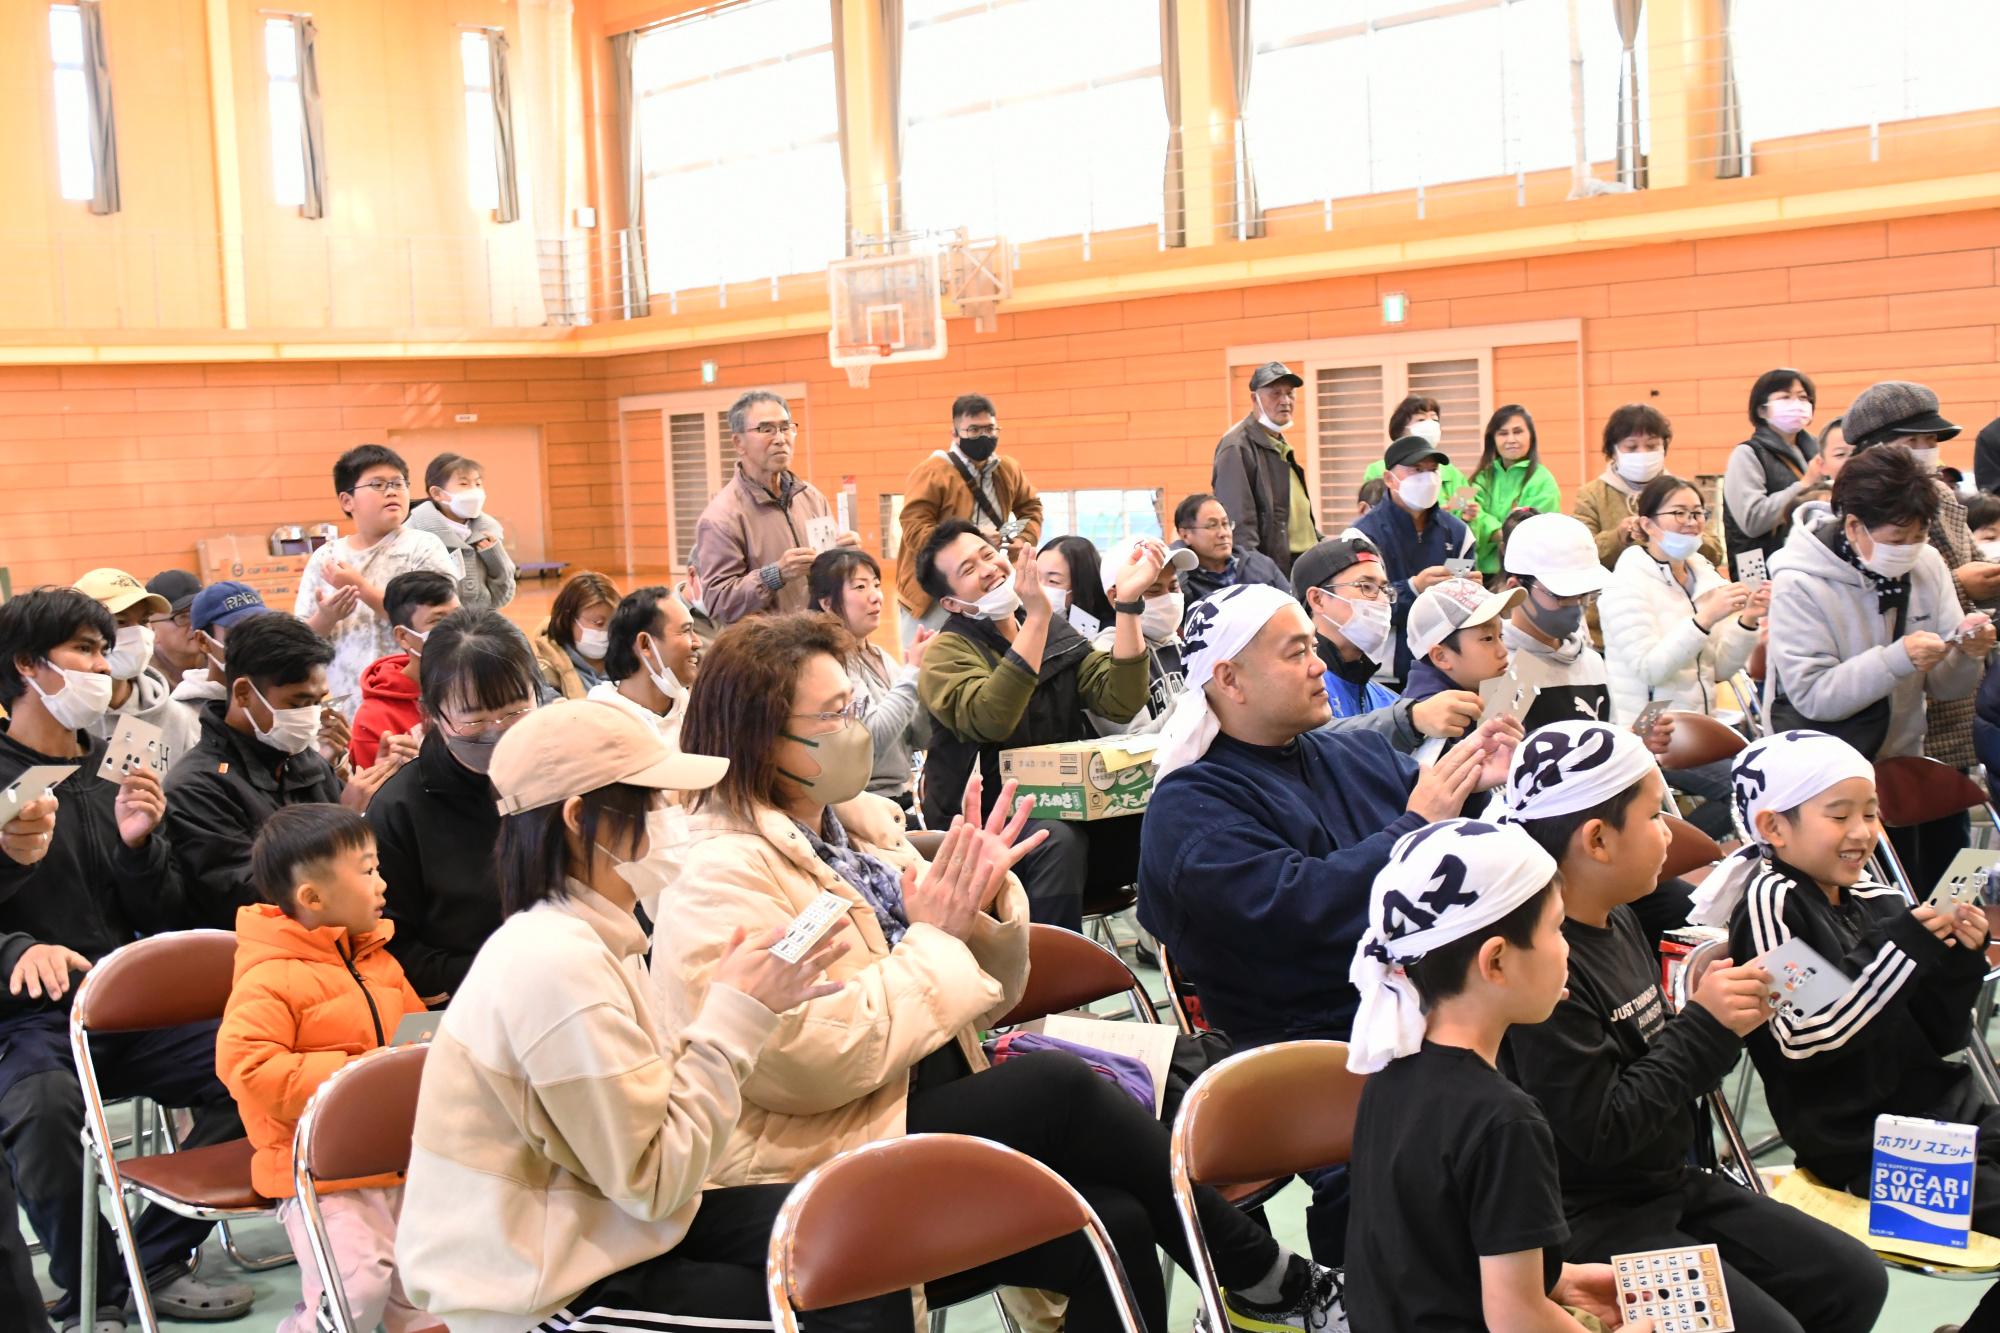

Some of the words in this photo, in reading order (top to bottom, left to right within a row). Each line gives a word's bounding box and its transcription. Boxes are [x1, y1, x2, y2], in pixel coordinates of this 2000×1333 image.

[1610, 1001, 1635, 1022] JUST
[1923, 1141, 1972, 1157] スエット
[1875, 1168, 1969, 1196] POCARI
[1874, 1183, 1960, 1209] SWEAT
[1619, 1261, 1628, 1272] 10
[1635, 1260, 1645, 1270] 13
[1668, 1256, 1677, 1266] 12
[1639, 1276, 1648, 1286] 19
[1672, 1271, 1681, 1282] 18
[1622, 1277, 1631, 1288] 30
[1655, 1273, 1664, 1284] 29
[1661, 1305, 1670, 1316] 54
[1675, 1287, 1684, 1298] 44
[1691, 1285, 1700, 1296] 38
[1678, 1303, 1687, 1314] 59
[1628, 1309, 1638, 1320] 55
[1681, 1319, 1691, 1330] 75
